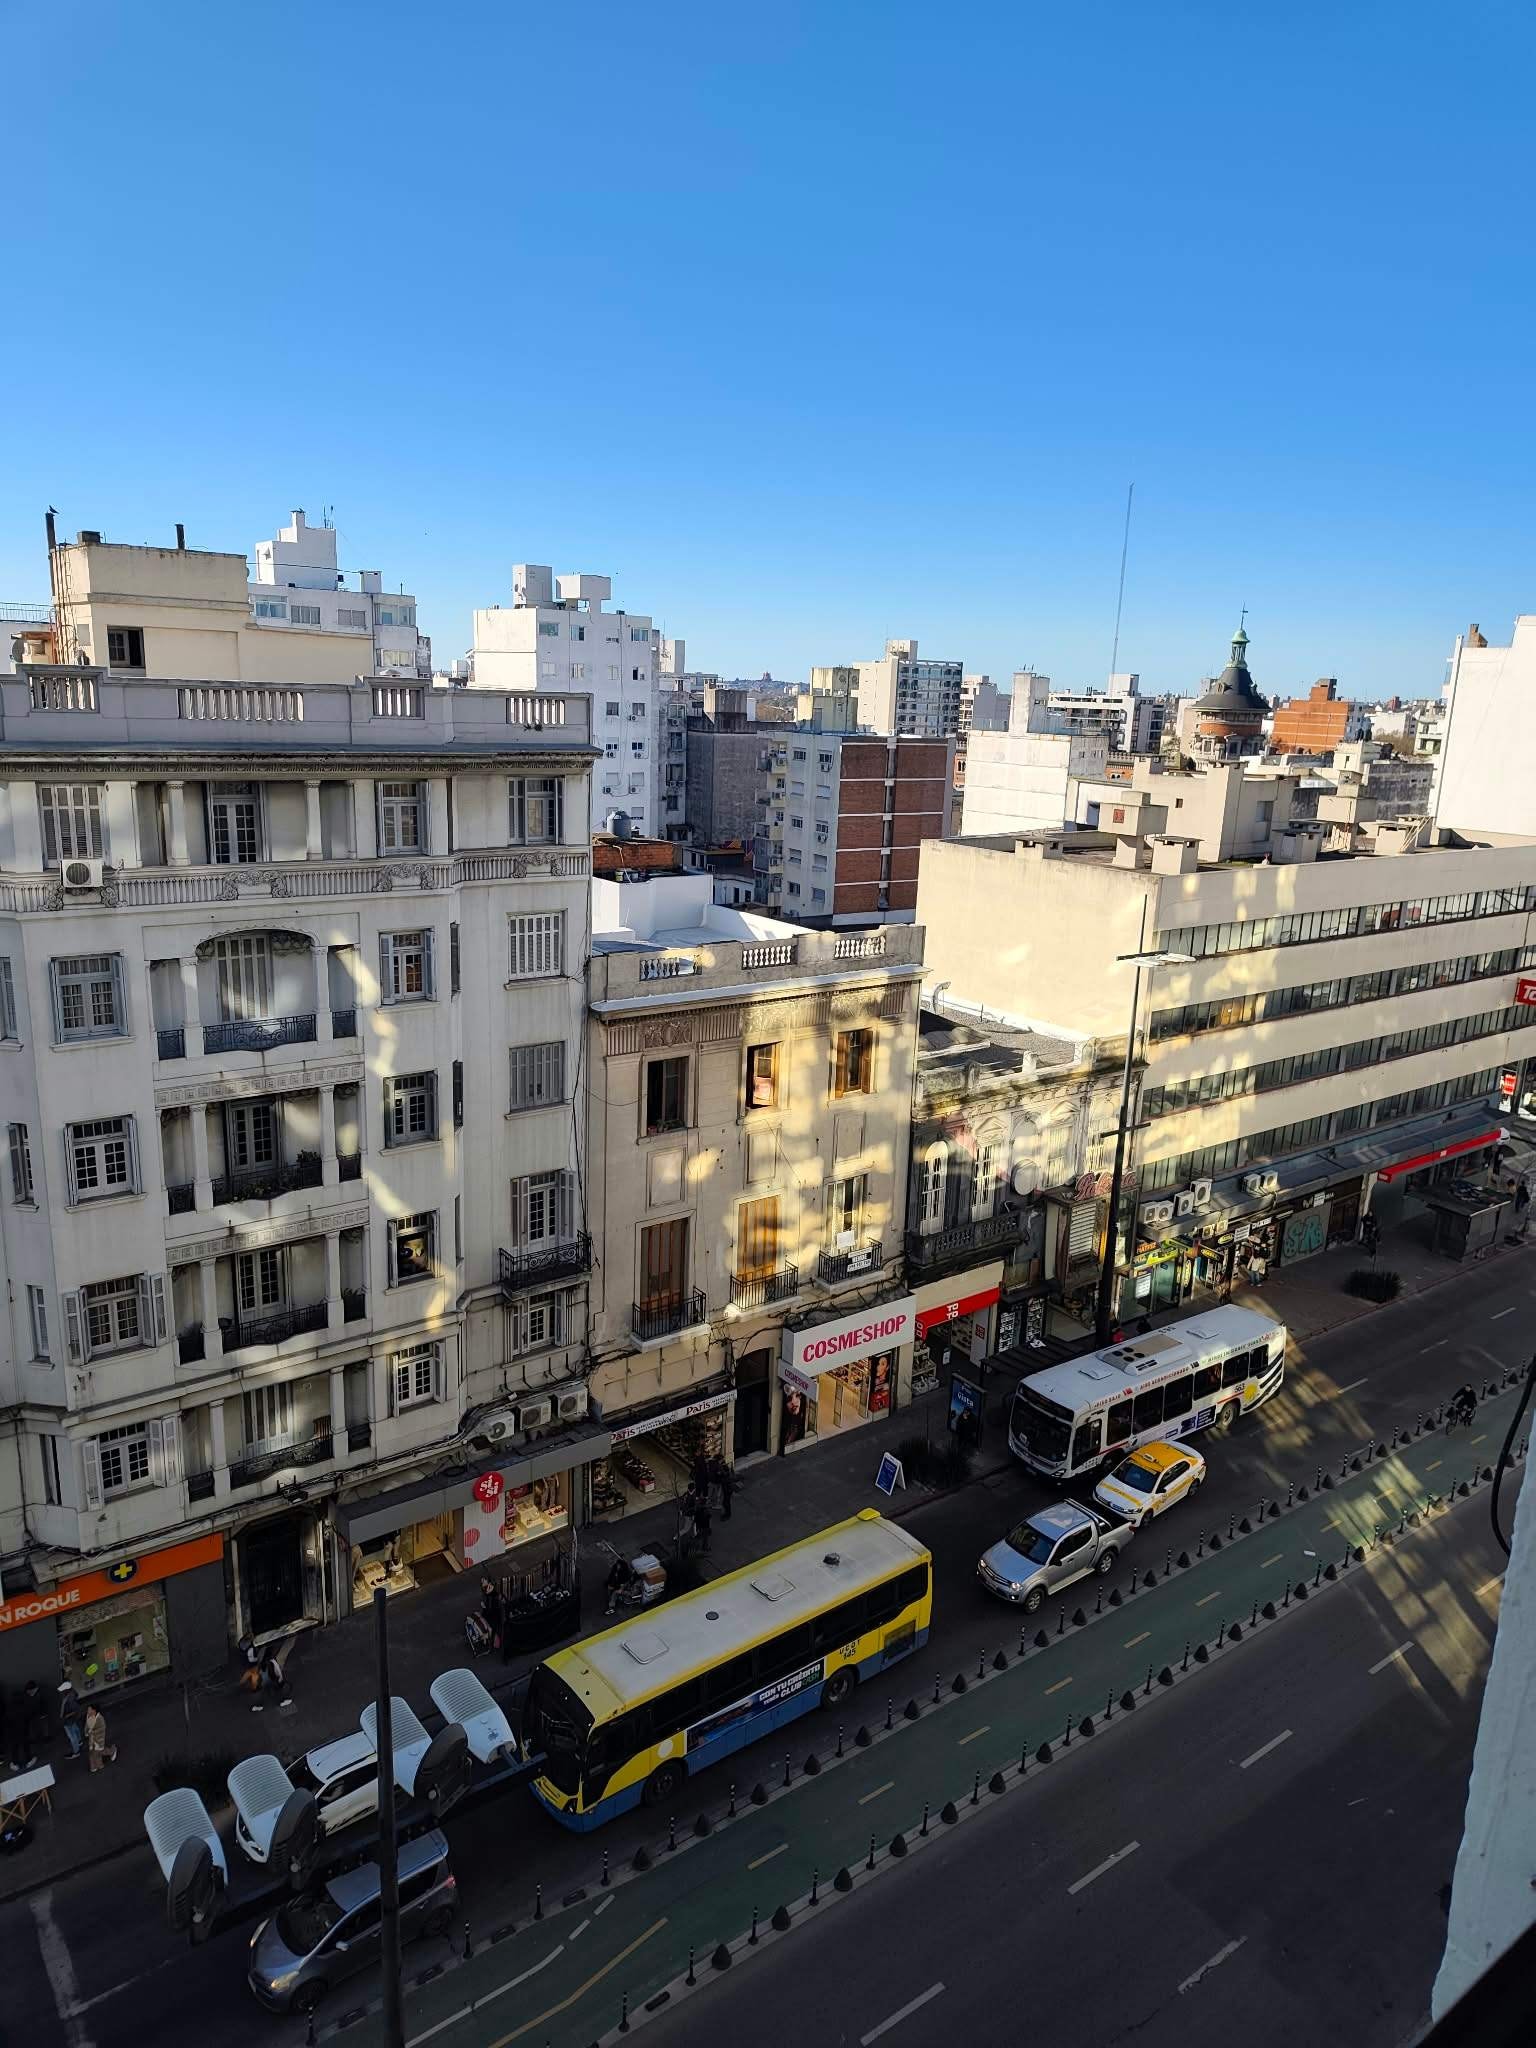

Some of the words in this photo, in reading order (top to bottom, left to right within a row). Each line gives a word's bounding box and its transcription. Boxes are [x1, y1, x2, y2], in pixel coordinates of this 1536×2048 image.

[803, 1314, 907, 1363] COSMESHOP
[686, 1401, 711, 1416] Paris
[14, 1588, 81, 1621] ROQUE
[759, 1688, 777, 1702] CON
[776, 1680, 787, 1692] TU
[780, 1681, 803, 1698] CLUB
